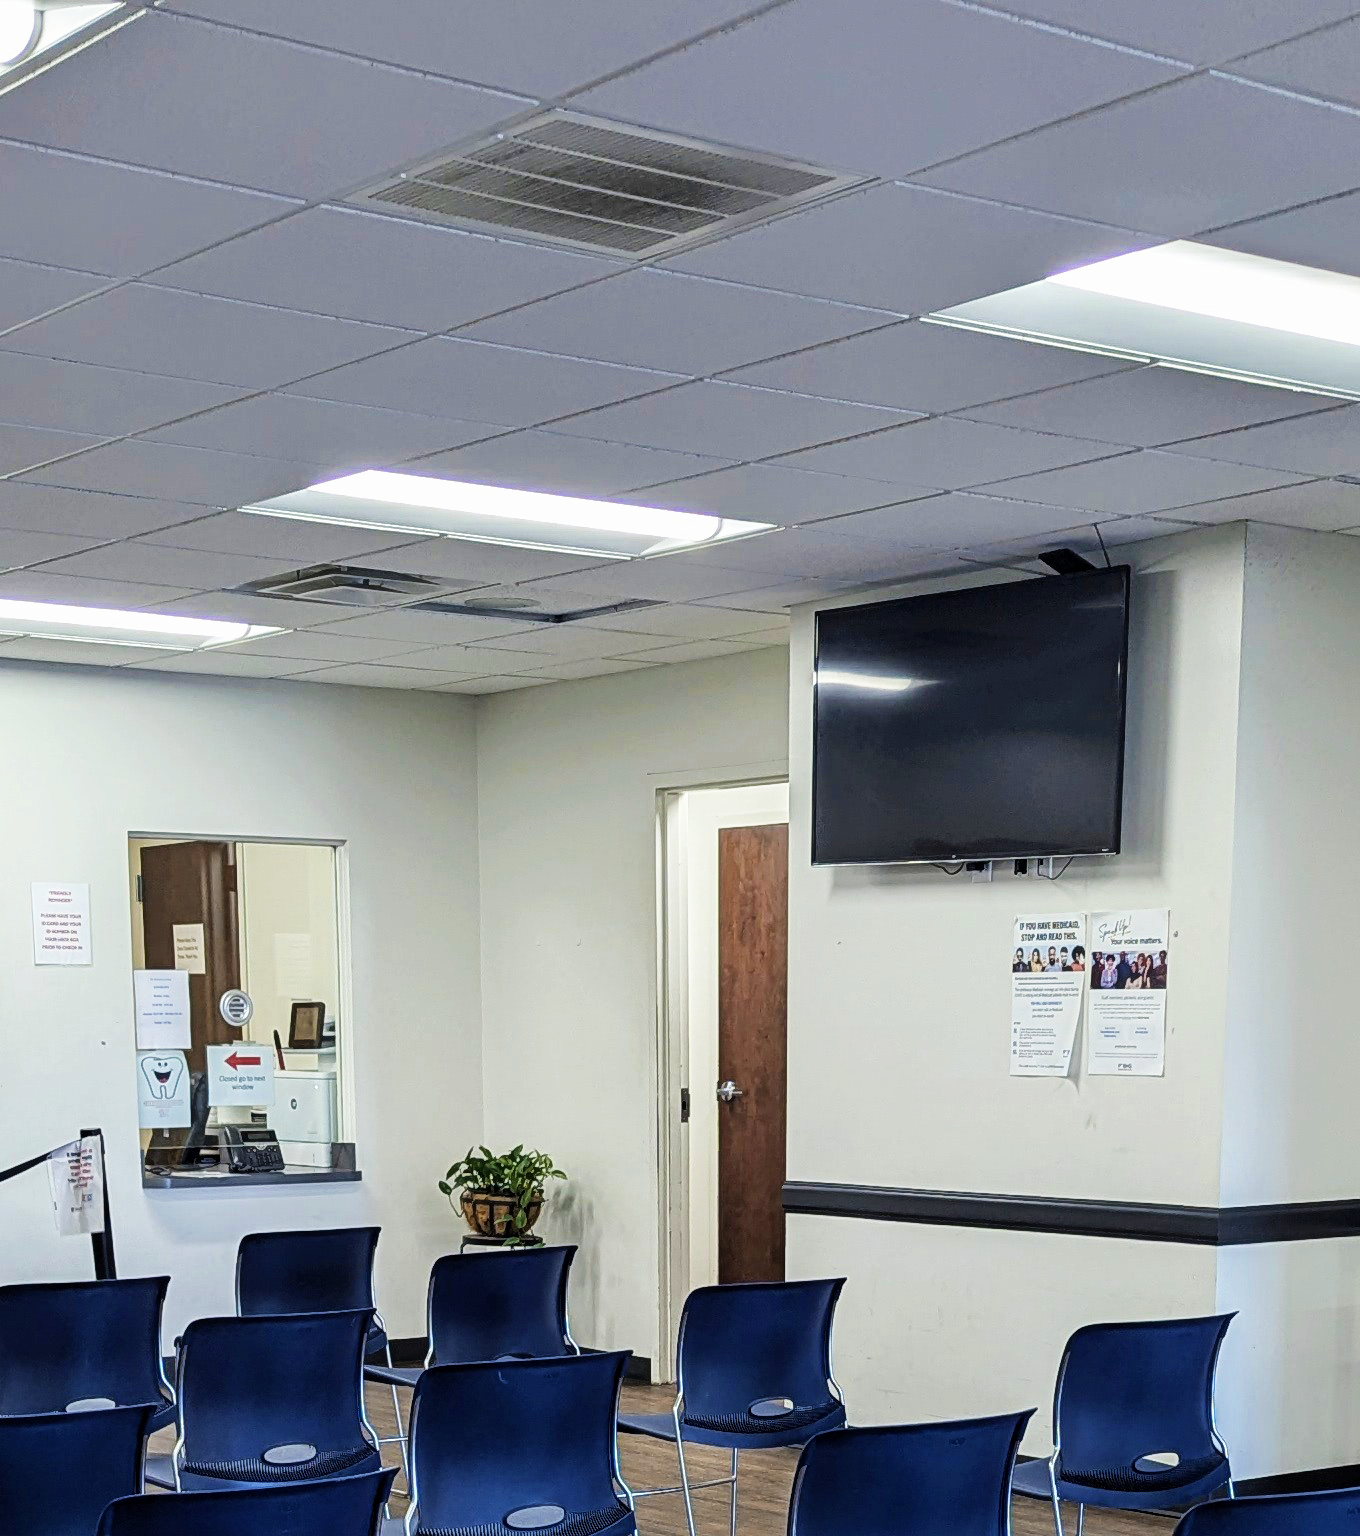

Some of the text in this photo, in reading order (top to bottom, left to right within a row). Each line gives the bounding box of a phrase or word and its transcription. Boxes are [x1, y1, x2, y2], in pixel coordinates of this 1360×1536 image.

[1019, 922, 1025, 931] IF
[1025, 922, 1036, 930] YOU
[1037, 921, 1051, 930] HAVE
[1021, 933, 1035, 942] STOP
[1036, 933, 1048, 941] AND
[1048, 932, 1063, 941] READ
[1110, 938, 1123, 946] Your
